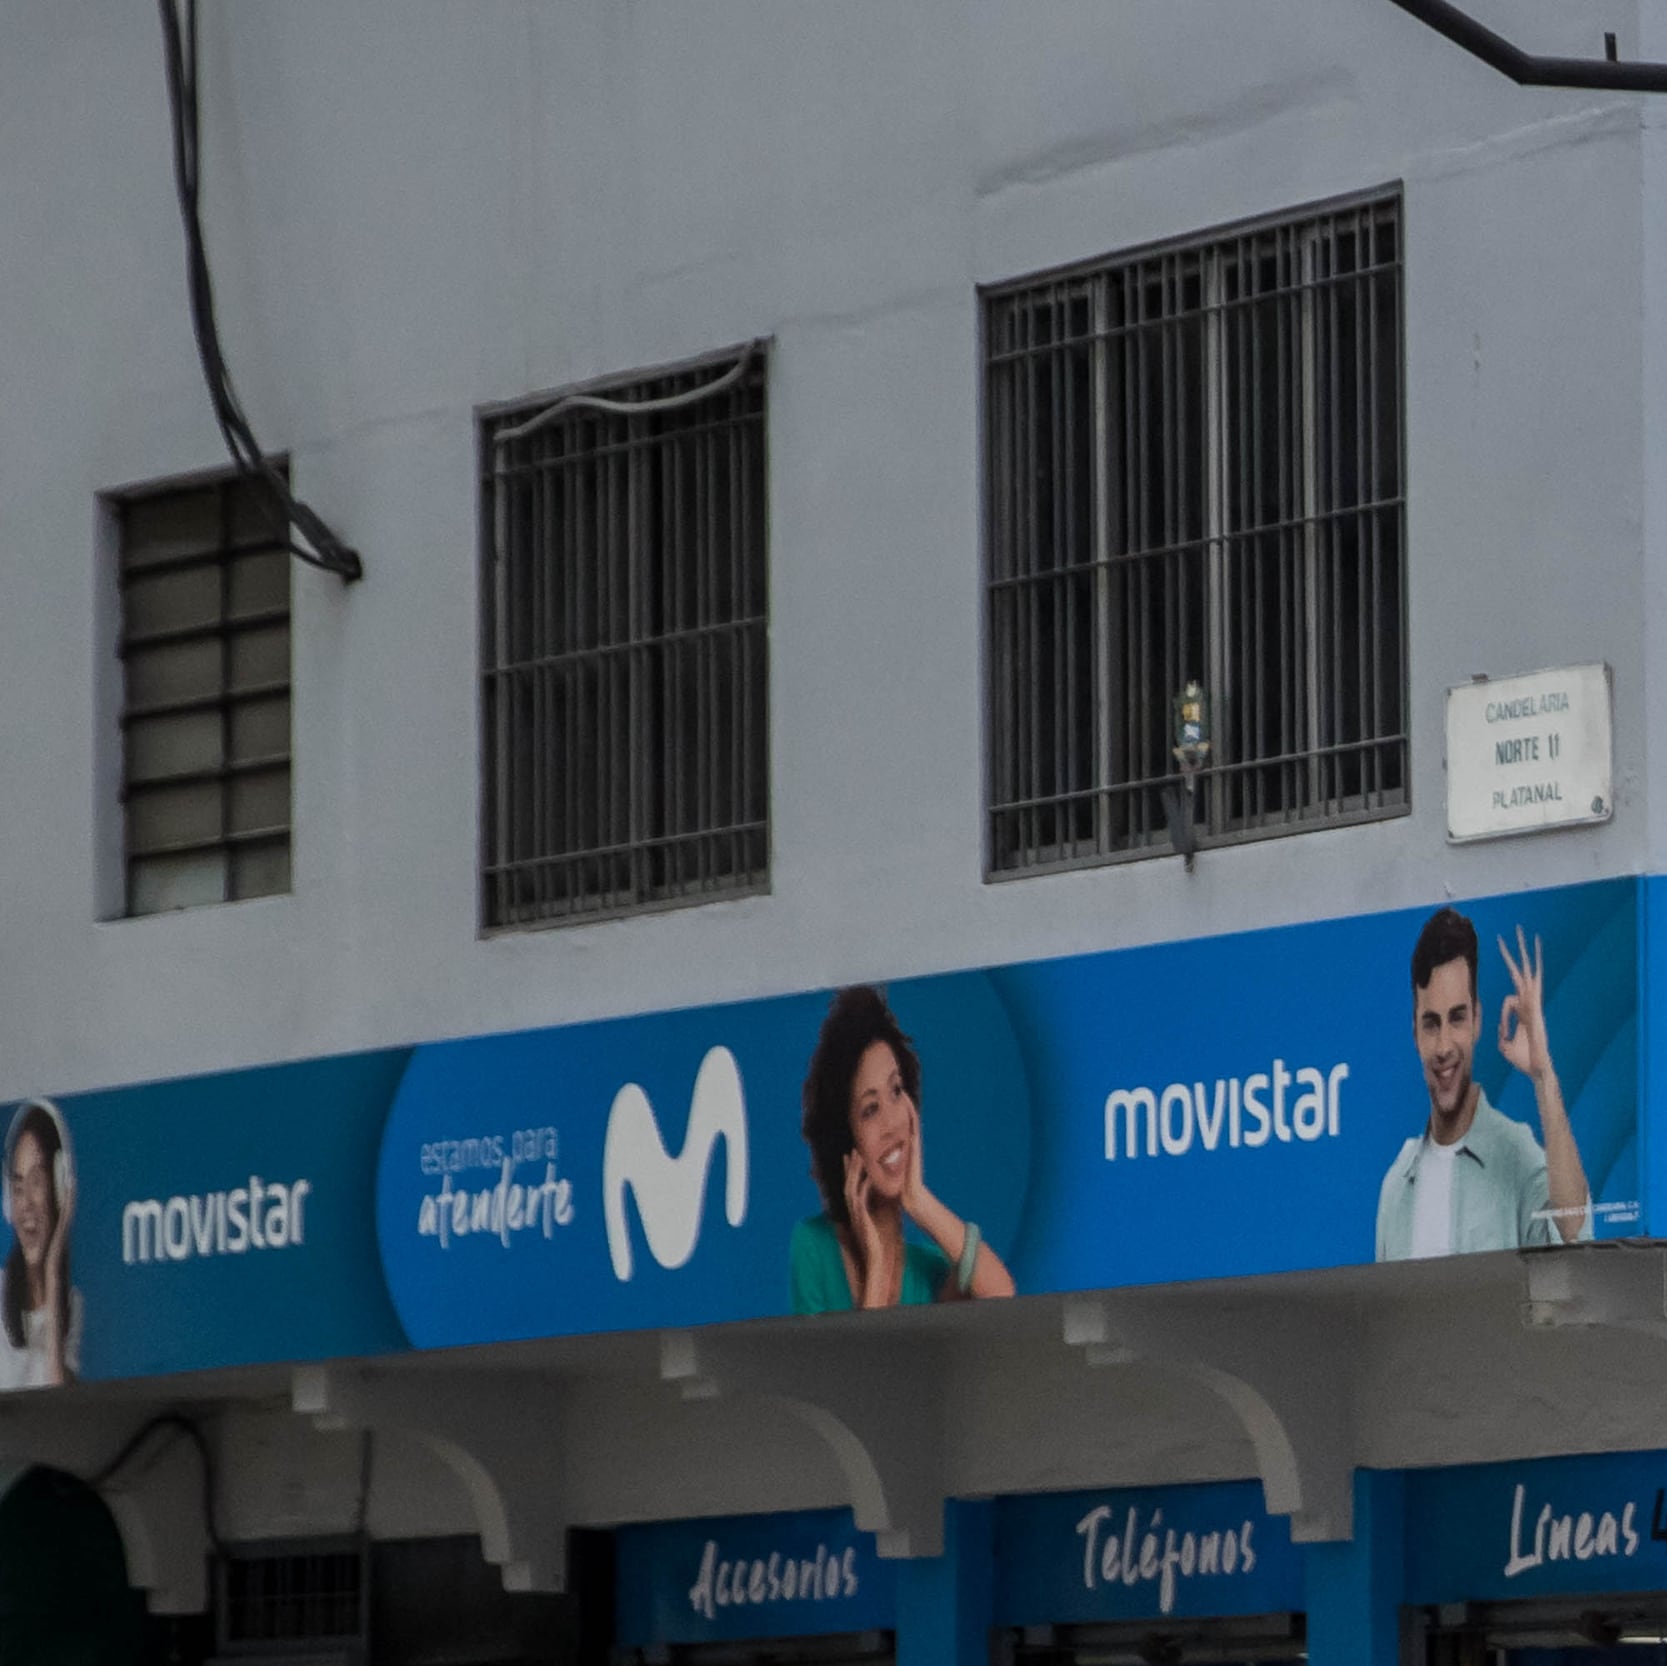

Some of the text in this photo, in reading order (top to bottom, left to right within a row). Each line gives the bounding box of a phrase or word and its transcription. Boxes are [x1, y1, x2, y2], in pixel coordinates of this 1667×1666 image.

[1485, 692, 1570, 724] CANDELARIA
[1495, 736, 1540, 766] NORTE
[1492, 781, 1563, 810] PLATANAL
[1104, 1058, 1350, 1161] movistar
[421, 1126, 558, 1175] estamos para
[122, 1176, 310, 1264] movistar
[418, 1156, 574, 1249] atenderte
[689, 1541, 859, 1620] Accesorios
[1076, 1504, 1257, 1613] Teléfonos
